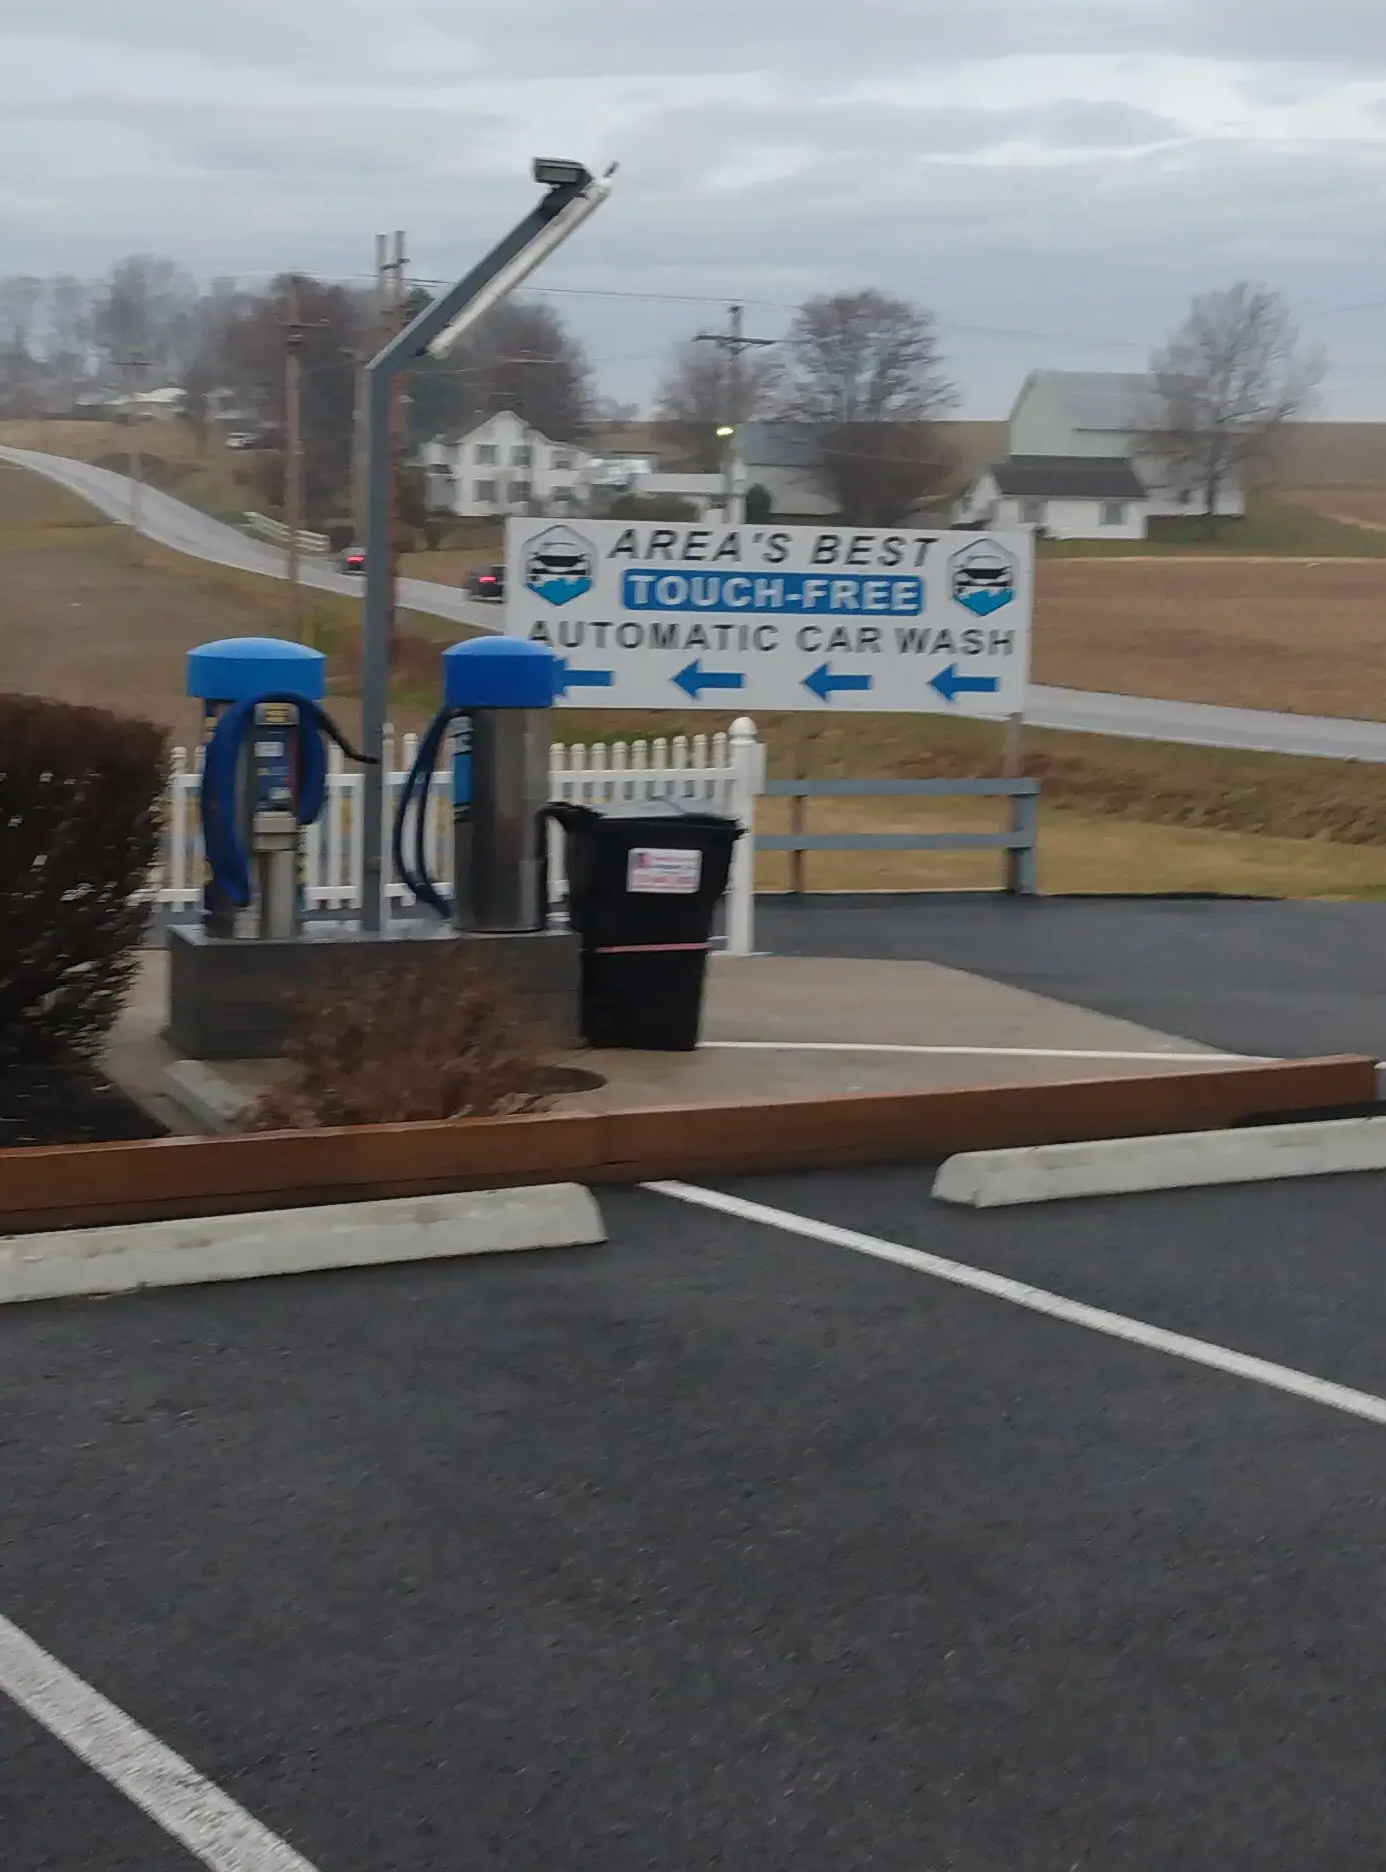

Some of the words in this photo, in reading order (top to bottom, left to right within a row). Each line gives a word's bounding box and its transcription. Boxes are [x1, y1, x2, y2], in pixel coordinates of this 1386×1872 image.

[607, 529, 792, 564] AREA'S
[809, 533, 939, 568] BEST
[627, 573, 920, 611] TOUCH-FREE
[526, 619, 778, 653] AUTOMATIC
[795, 626, 881, 655] CAR
[894, 628, 1014, 657] WASH
